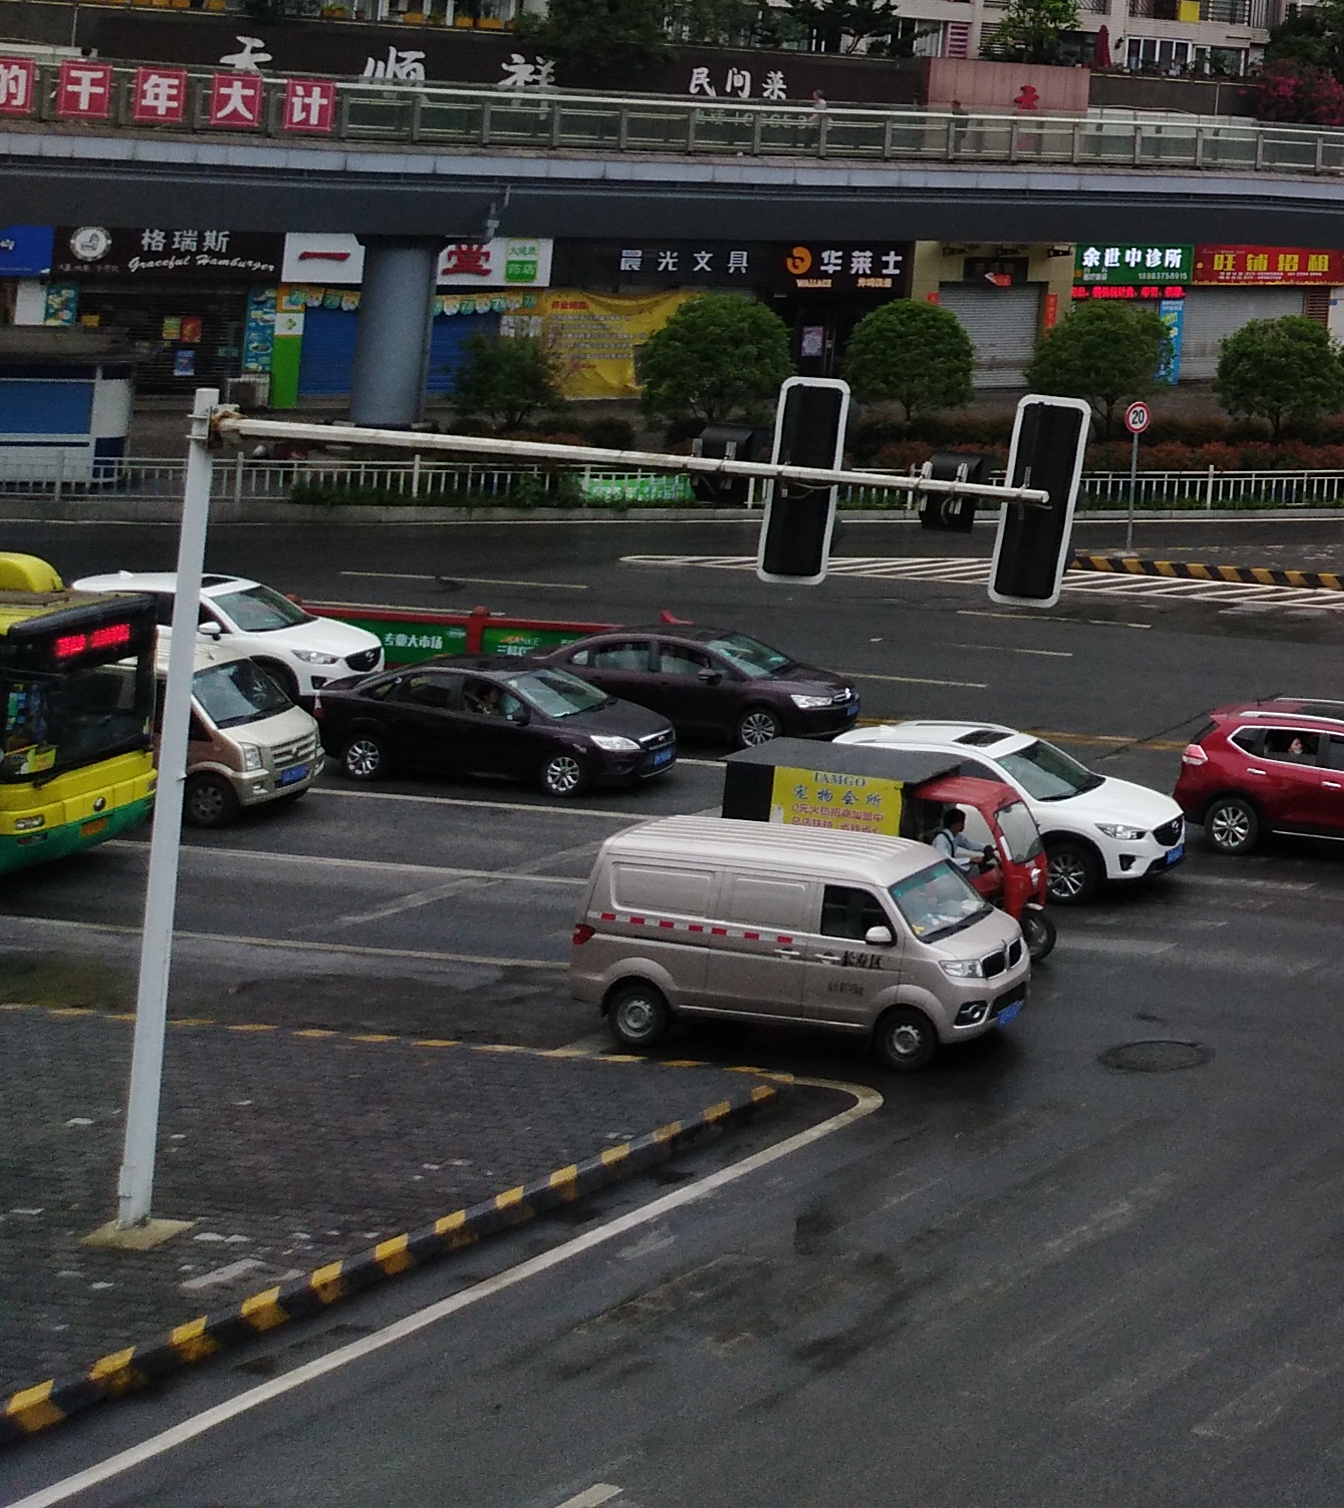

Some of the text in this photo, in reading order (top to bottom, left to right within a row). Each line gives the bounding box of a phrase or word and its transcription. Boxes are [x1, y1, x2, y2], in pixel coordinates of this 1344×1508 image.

[689, 67, 787, 100] 民间菜
[141, 229, 230, 253] 格瑞斯
[128, 255, 190, 272] Graceful
[195, 254, 275, 272] Hamburger
[620, 250, 749, 274] 晨光文具
[820, 250, 902, 275] 华莱士
[1082, 247, 1183, 268] 余世中诊所
[1213, 253, 1330, 272] 旺铺招租
[1131, 409, 1145, 424] 20
[793, 784, 883, 808] 宠物会所
